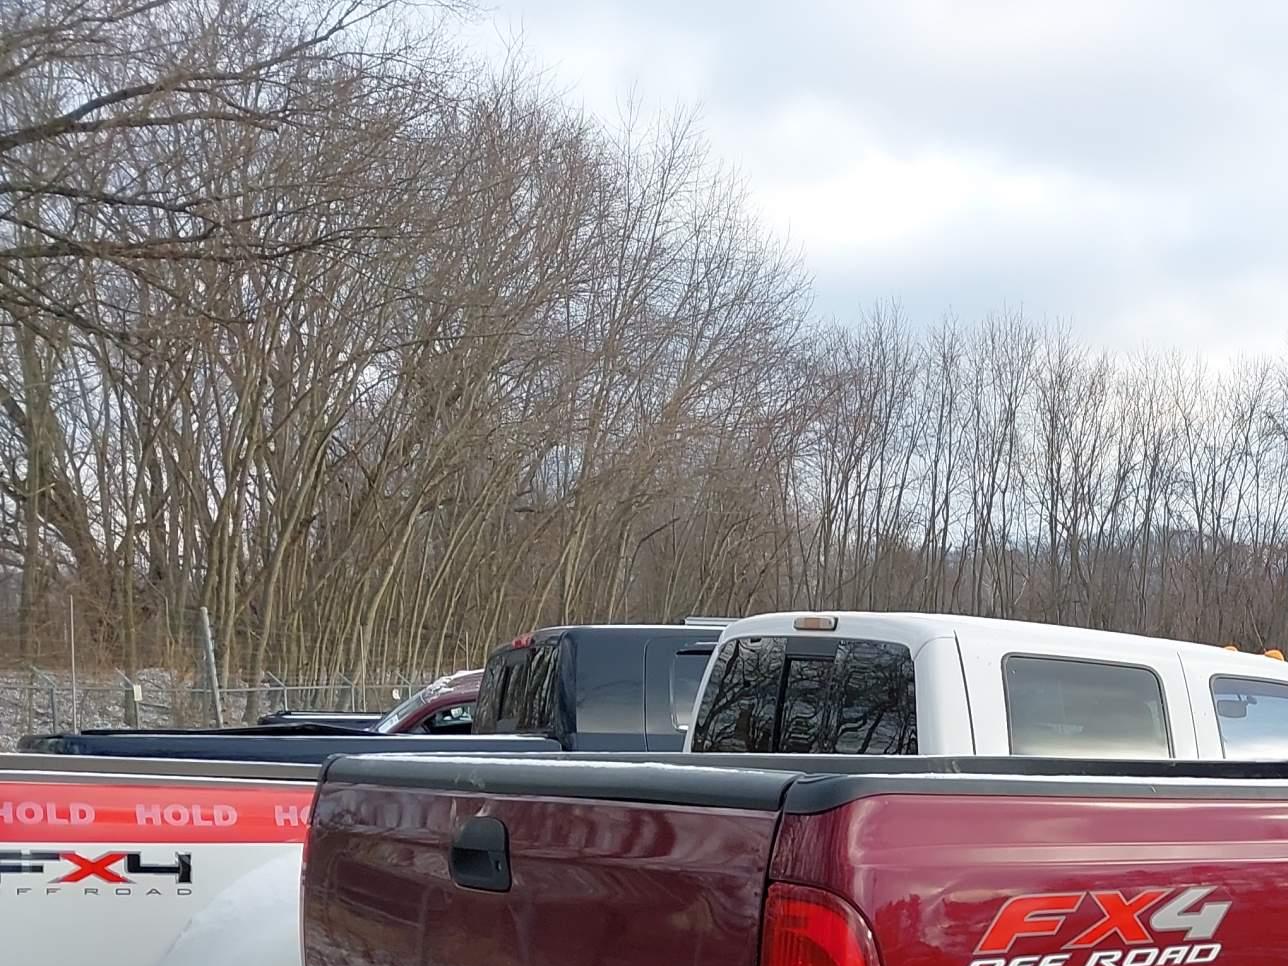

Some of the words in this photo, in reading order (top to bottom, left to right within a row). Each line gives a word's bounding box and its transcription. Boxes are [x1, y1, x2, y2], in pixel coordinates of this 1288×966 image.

[135, 803, 238, 827] HOLD
[84, 888, 192, 896] ROAD
[973, 885, 1233, 955] FX4
